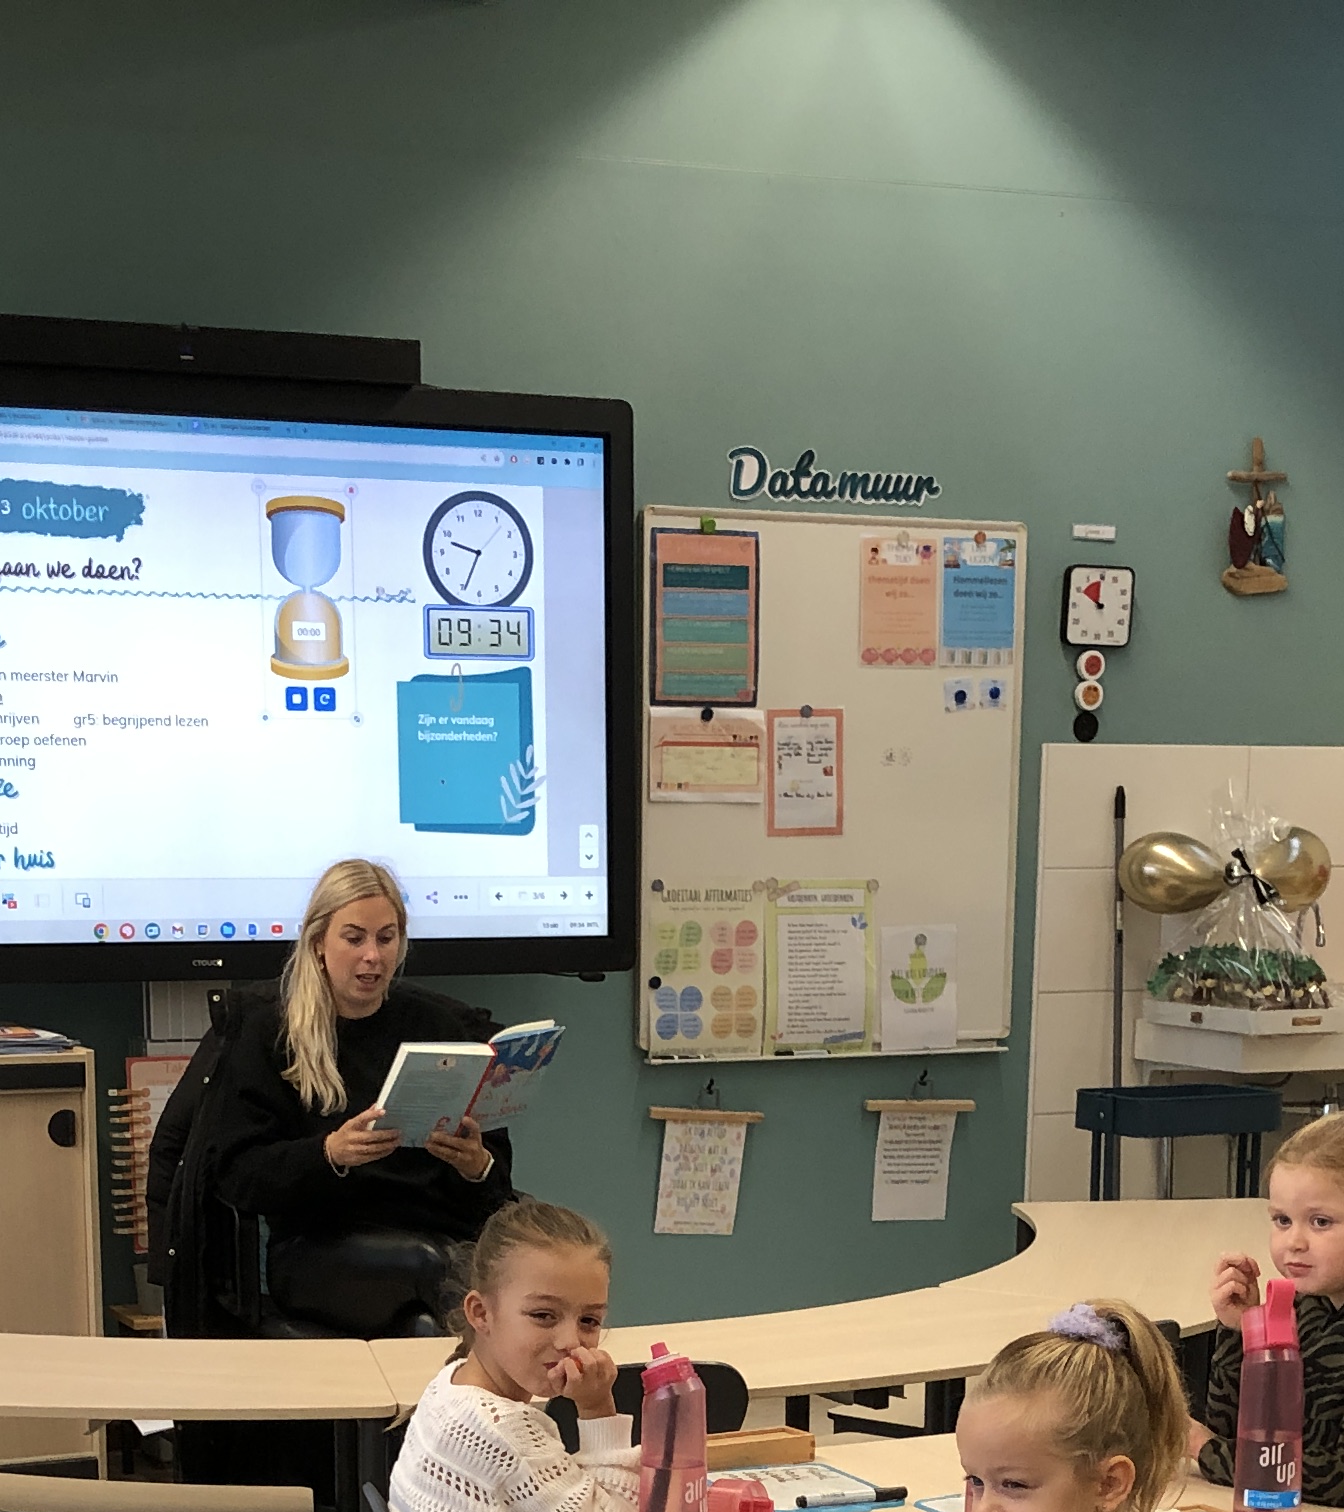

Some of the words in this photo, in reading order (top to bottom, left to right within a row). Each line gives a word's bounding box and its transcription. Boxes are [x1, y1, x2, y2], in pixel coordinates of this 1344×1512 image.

[728, 447, 941, 503] Datamuur
[21, 496, 110, 522] oktober
[474, 509, 482, 517] 12
[46, 560, 75, 578] we
[81, 557, 143, 580] doen?
[477, 590, 482, 598] 6
[297, 628, 321, 636] 00:00
[438, 618, 520, 647] 09:34
[11, 670, 69, 682] meerster
[73, 671, 118, 683] Marvin
[73, 714, 99, 727] gr5:
[103, 714, 172, 729] begrijpend
[176, 715, 209, 727] lezen
[418, 714, 436, 726] Zijn
[439, 717, 449, 725] er
[451, 715, 494, 728] vandaag
[33, 734, 86, 747] oefenen
[418, 730, 497, 743] bijzonderheden?
[13, 846, 56, 871] huis
[1259, 1443, 1284, 1467] air
[1277, 1462, 1295, 1486] up
[685, 1477, 704, 1504] air
